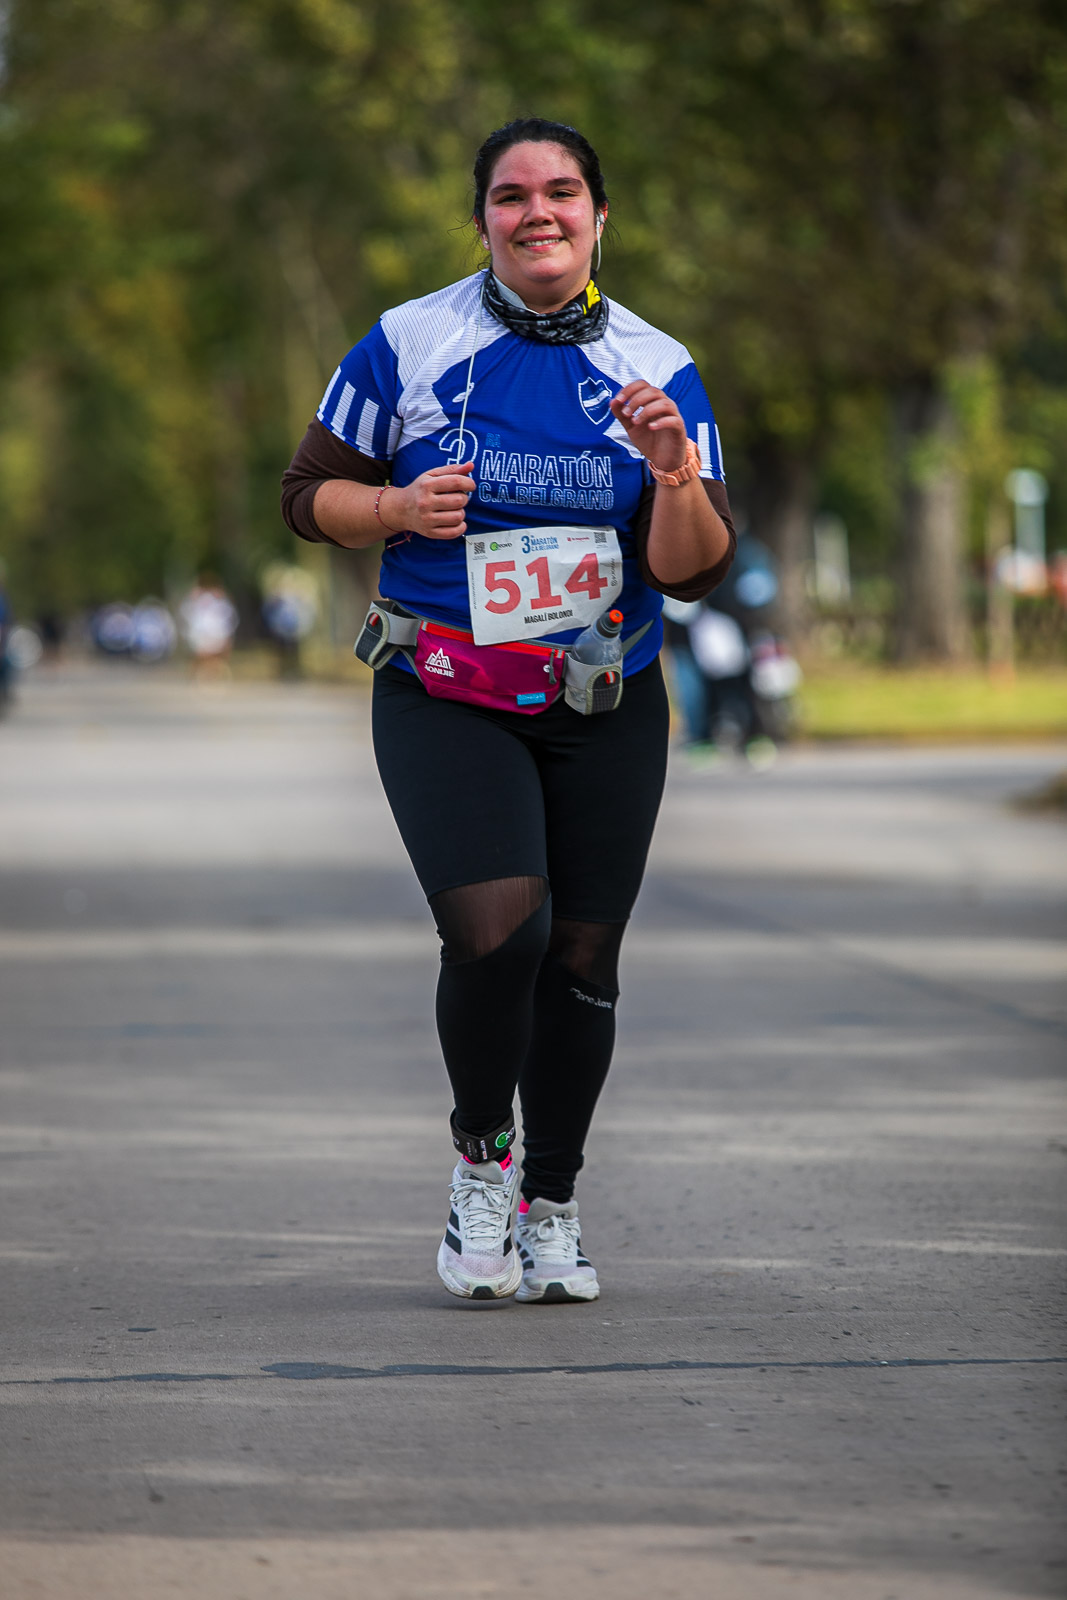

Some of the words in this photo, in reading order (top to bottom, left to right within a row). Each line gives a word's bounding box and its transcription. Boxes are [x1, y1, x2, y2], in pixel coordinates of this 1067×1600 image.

[480, 450, 614, 488] MARATÓN
[521, 535, 531, 554] 3
[484, 552, 609, 615] 514
